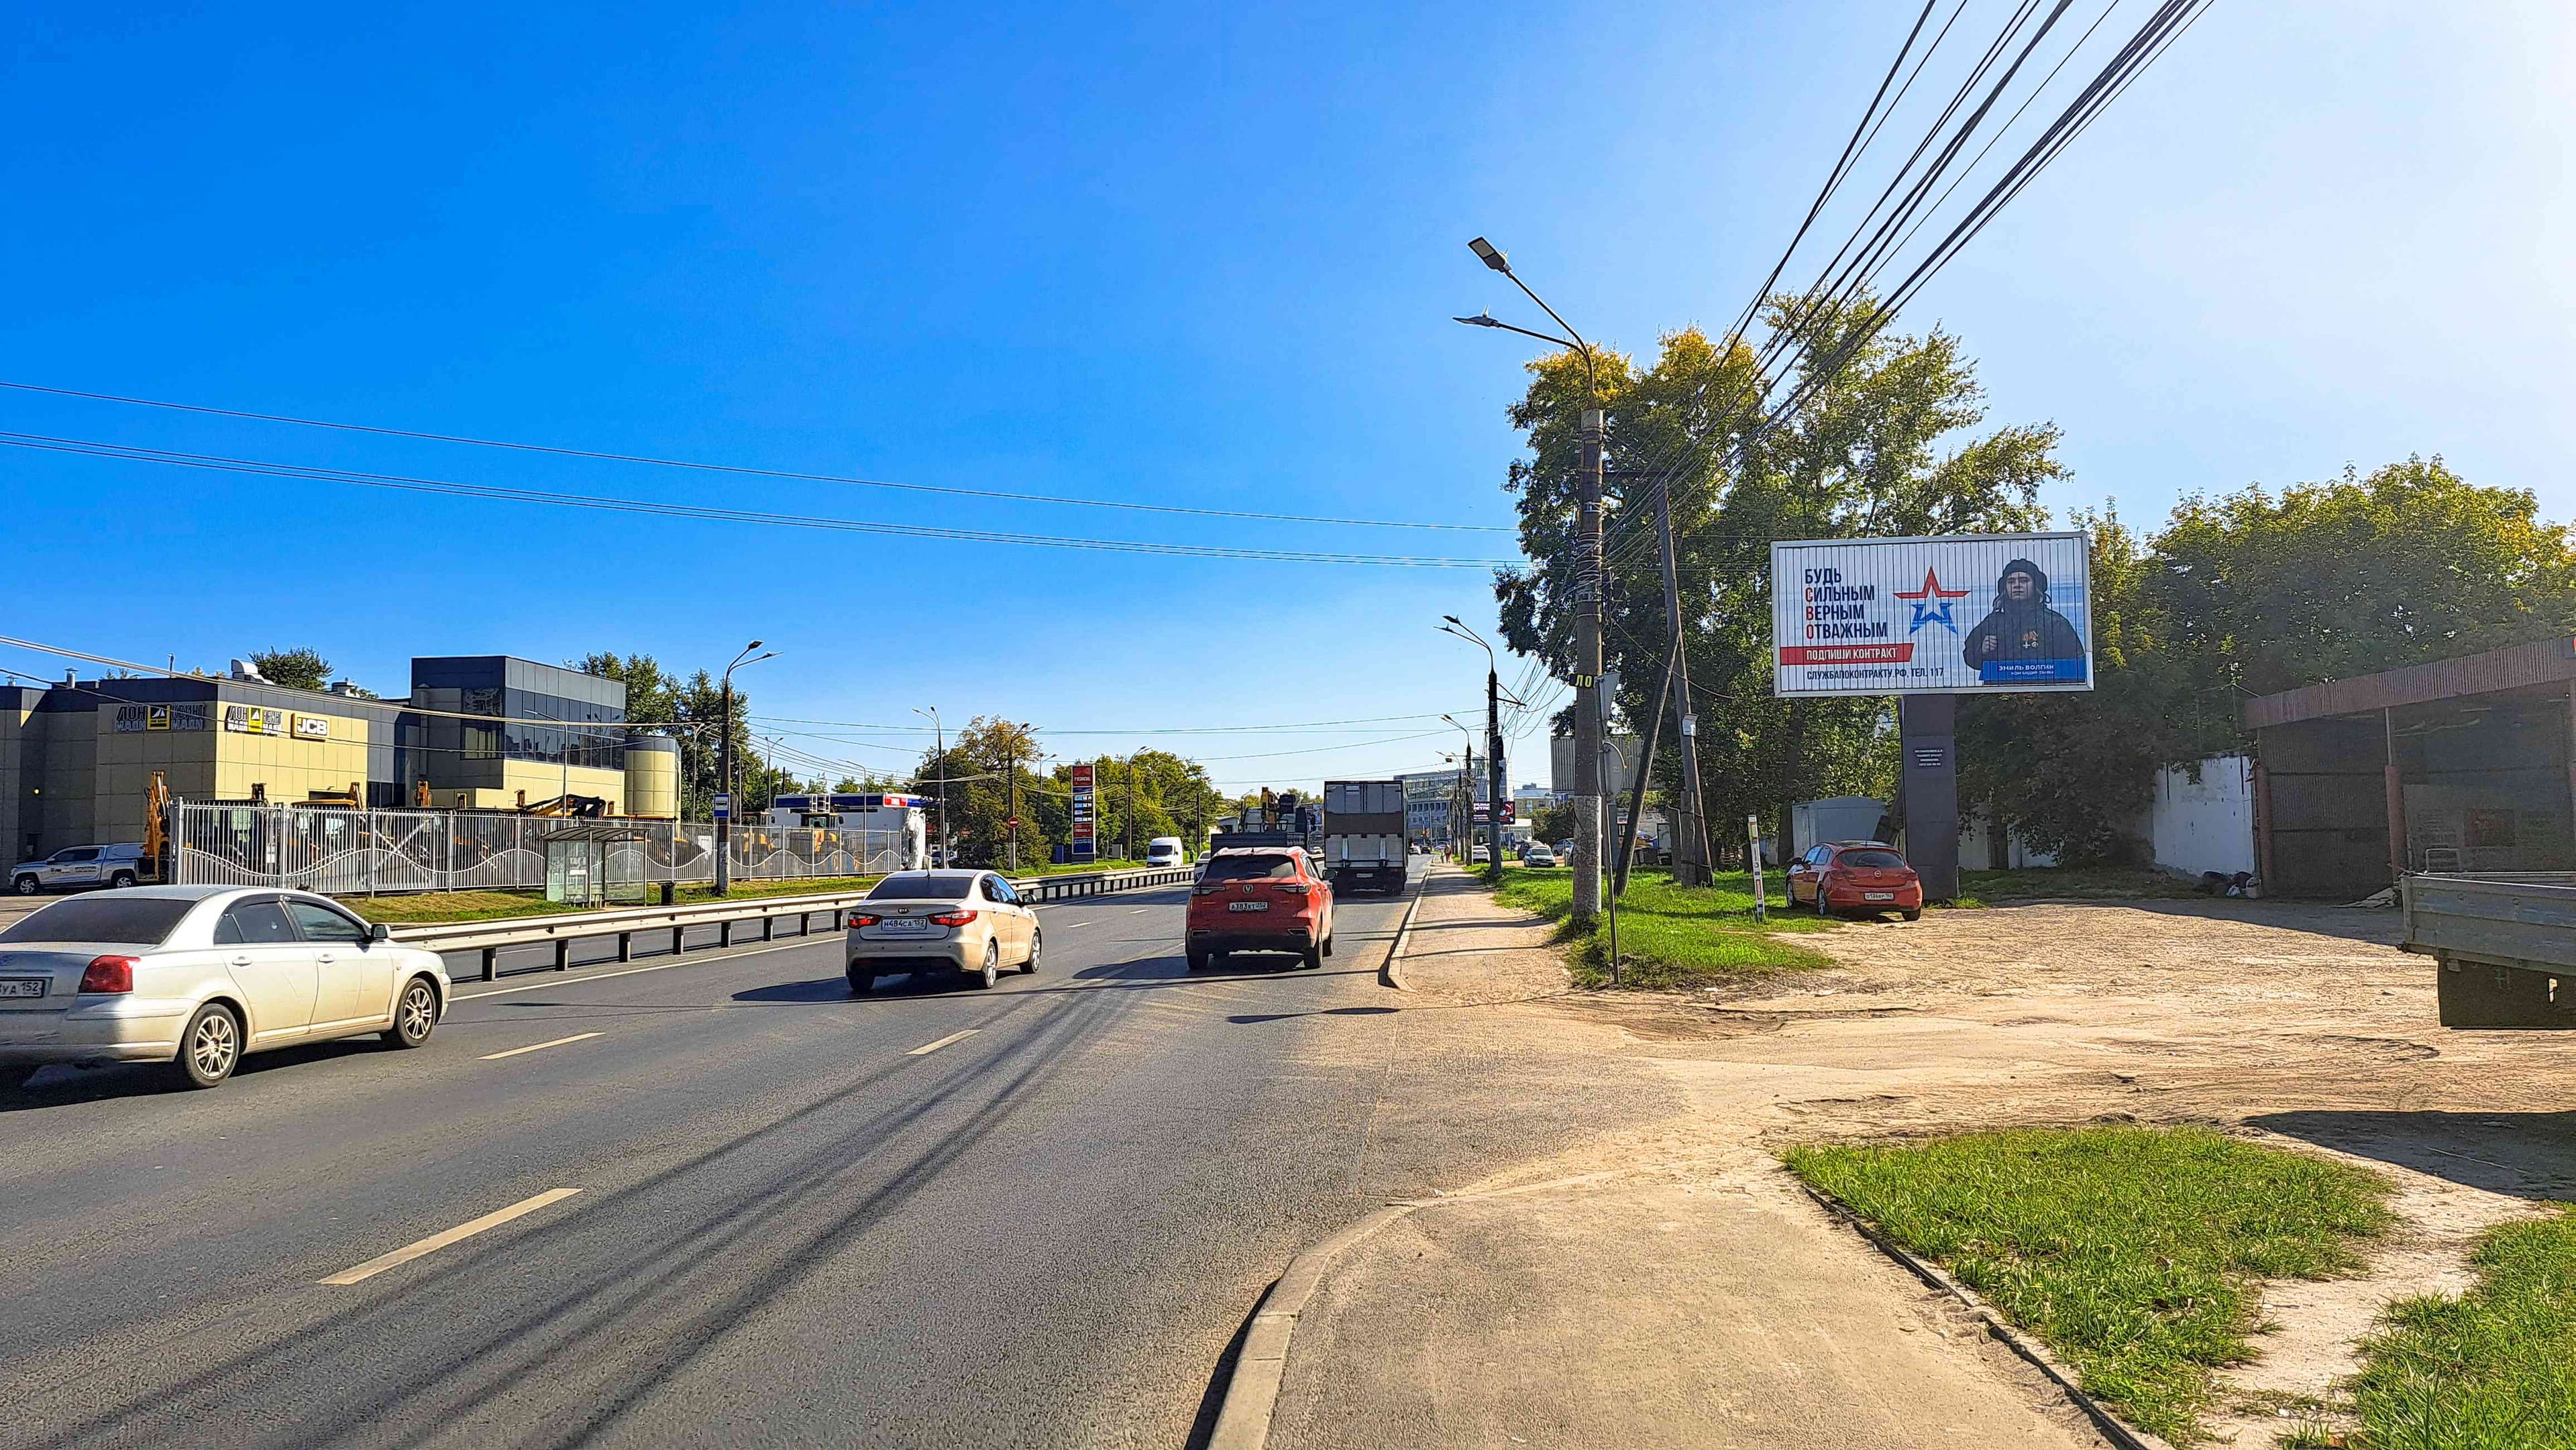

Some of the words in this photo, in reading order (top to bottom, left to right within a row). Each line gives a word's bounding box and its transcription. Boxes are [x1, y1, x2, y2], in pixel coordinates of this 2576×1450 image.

[1805, 568, 1841, 585] БУДЬ
[1805, 585, 1875, 603] СИЛЬНЫМ
[1806, 604, 1864, 621] ВЕРНЫМ
[1807, 622, 1888, 640] ОТВАЖНЫМ
[1807, 649, 1851, 661] ПОДПИШИ
[1853, 647, 1898, 659] КОНТРАКТ
[1912, 668, 1928, 677] ТЕЛ.
[1930, 667, 1945, 677] 117
[116, 705, 146, 720] ЛОН
[297, 717, 327, 736] JCB
[21, 982, 39, 992] 152
